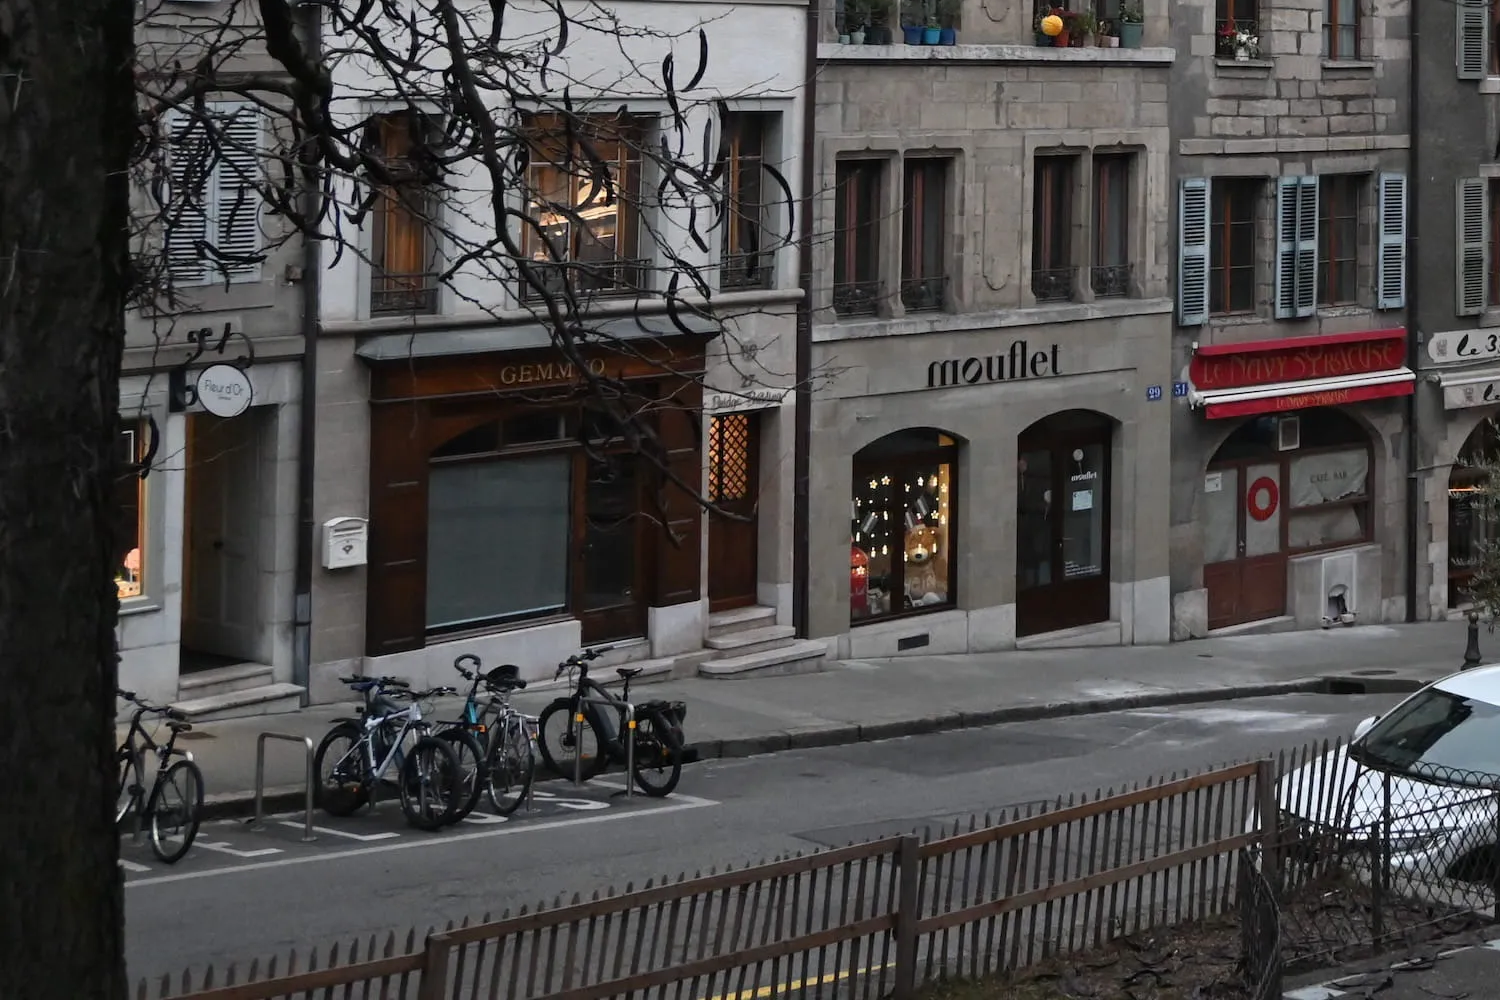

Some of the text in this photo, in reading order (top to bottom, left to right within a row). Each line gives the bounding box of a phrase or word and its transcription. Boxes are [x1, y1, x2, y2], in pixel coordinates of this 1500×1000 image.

[501, 359, 605, 385] GEMMO
[926, 340, 1063, 387] mouflet
[1148, 386, 1161, 399] 29
